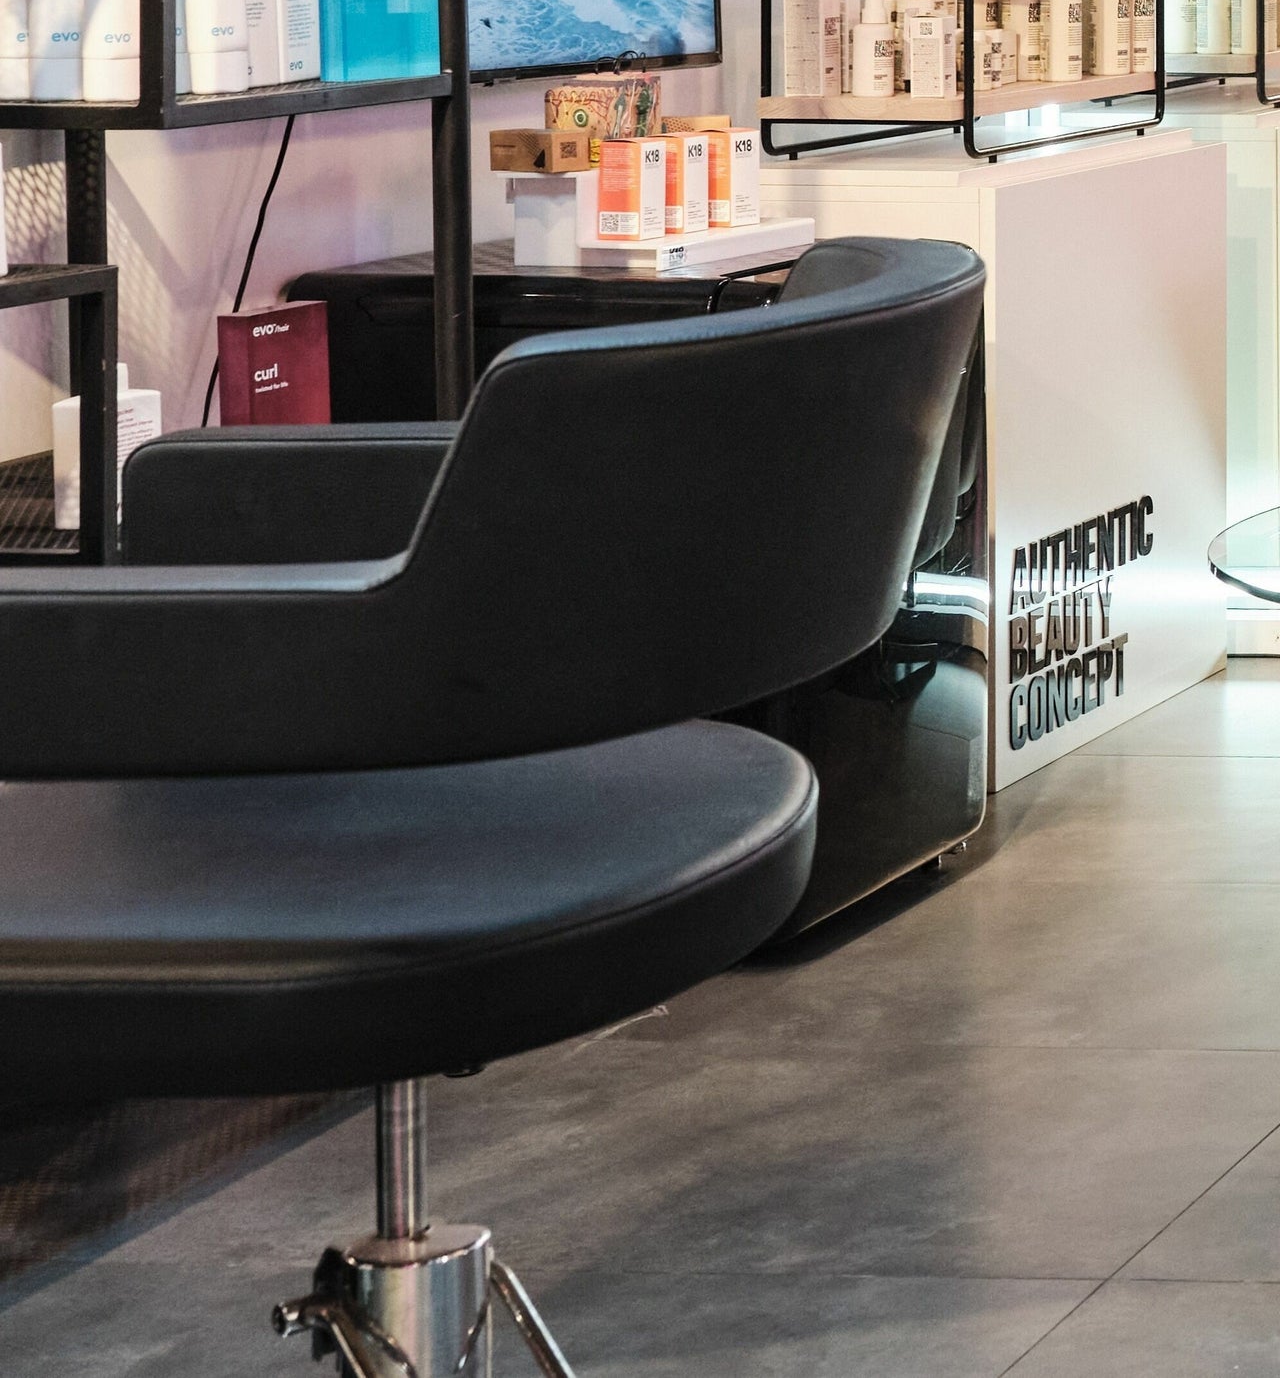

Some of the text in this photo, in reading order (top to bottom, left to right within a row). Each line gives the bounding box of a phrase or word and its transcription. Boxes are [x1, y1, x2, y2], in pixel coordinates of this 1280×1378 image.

[51, 31, 80, 42] evo
[211, 25, 235, 37] evo
[104, 33, 132, 44] evo
[289, 60, 303, 71] evo
[688, 144, 703, 158] K18
[735, 139, 753, 153] K18
[644, 149, 660, 163] K18
[254, 363, 278, 382] curl
[1008, 495, 1153, 615] AUTHENTIC
[1008, 574, 1113, 684] BEAUTY
[1009, 632, 1128, 750] CONCEPT
